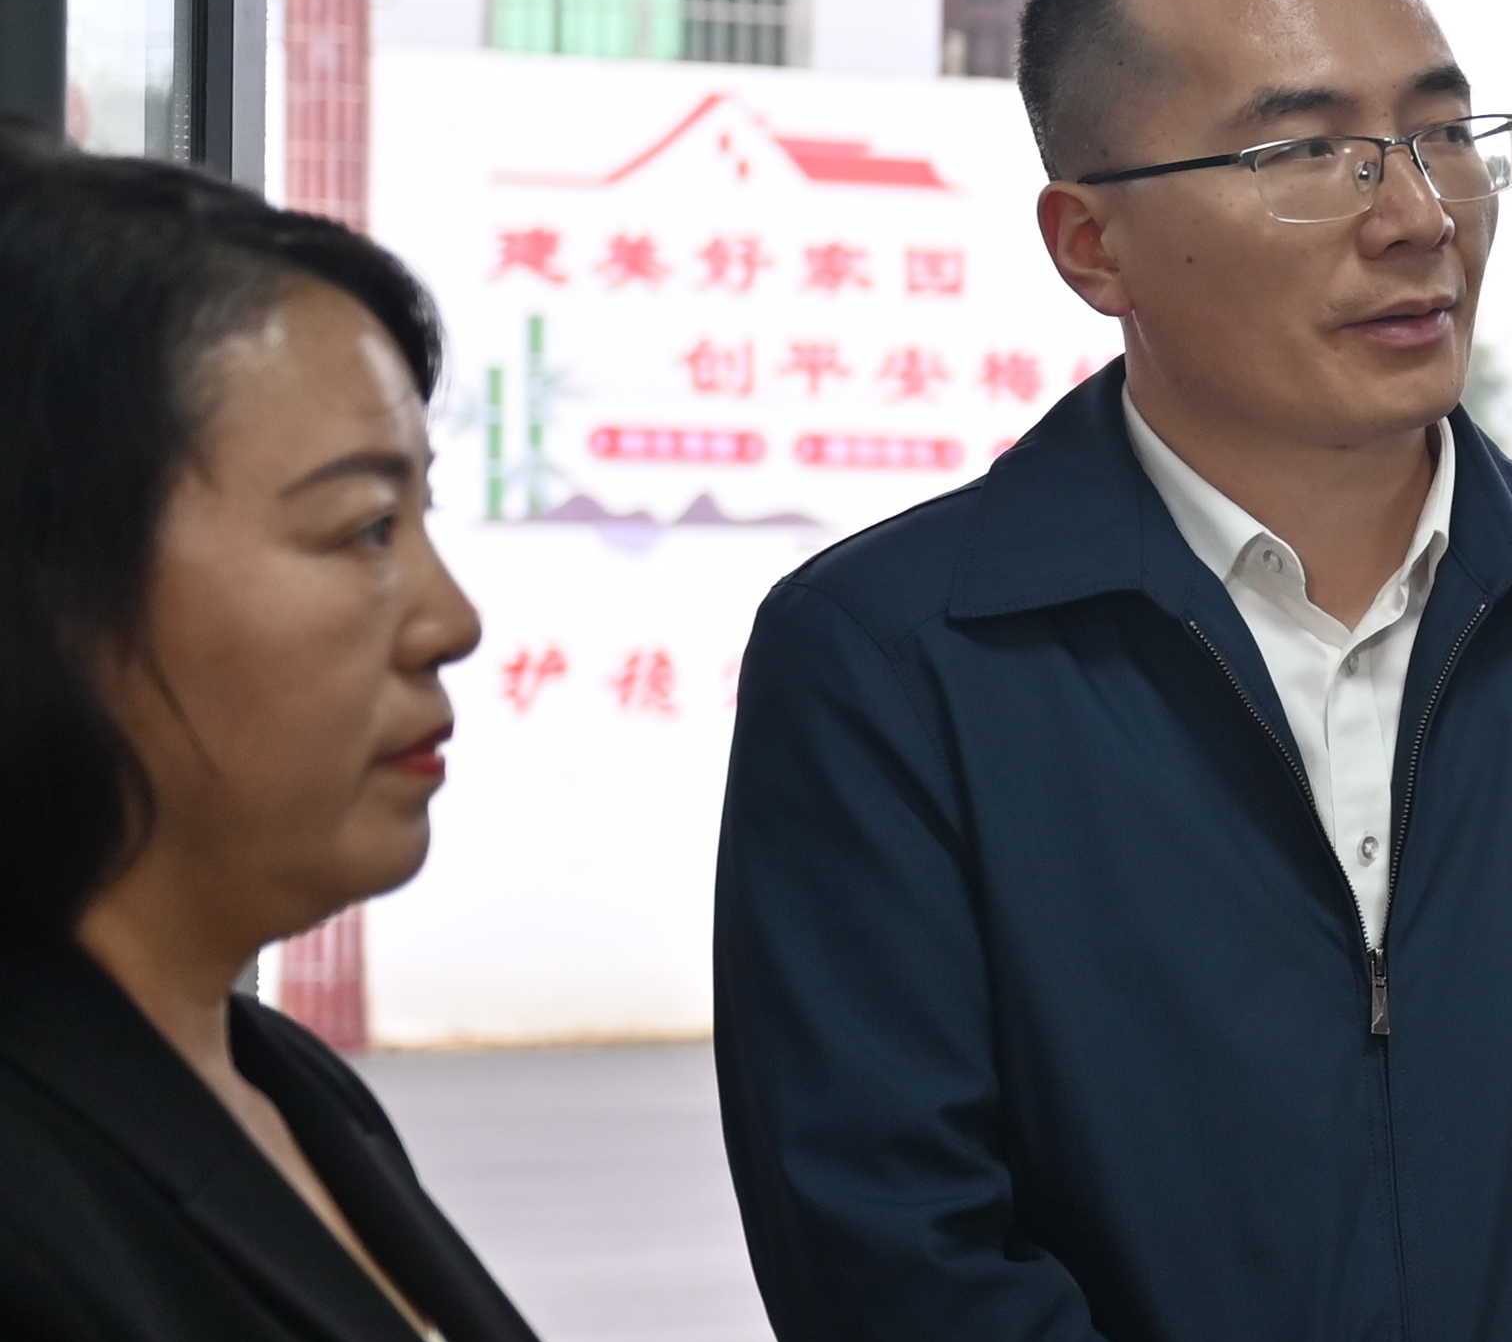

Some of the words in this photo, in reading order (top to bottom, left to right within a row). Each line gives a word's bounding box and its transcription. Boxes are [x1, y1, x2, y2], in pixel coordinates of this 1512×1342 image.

[489, 225, 970, 297] 建美好家园
